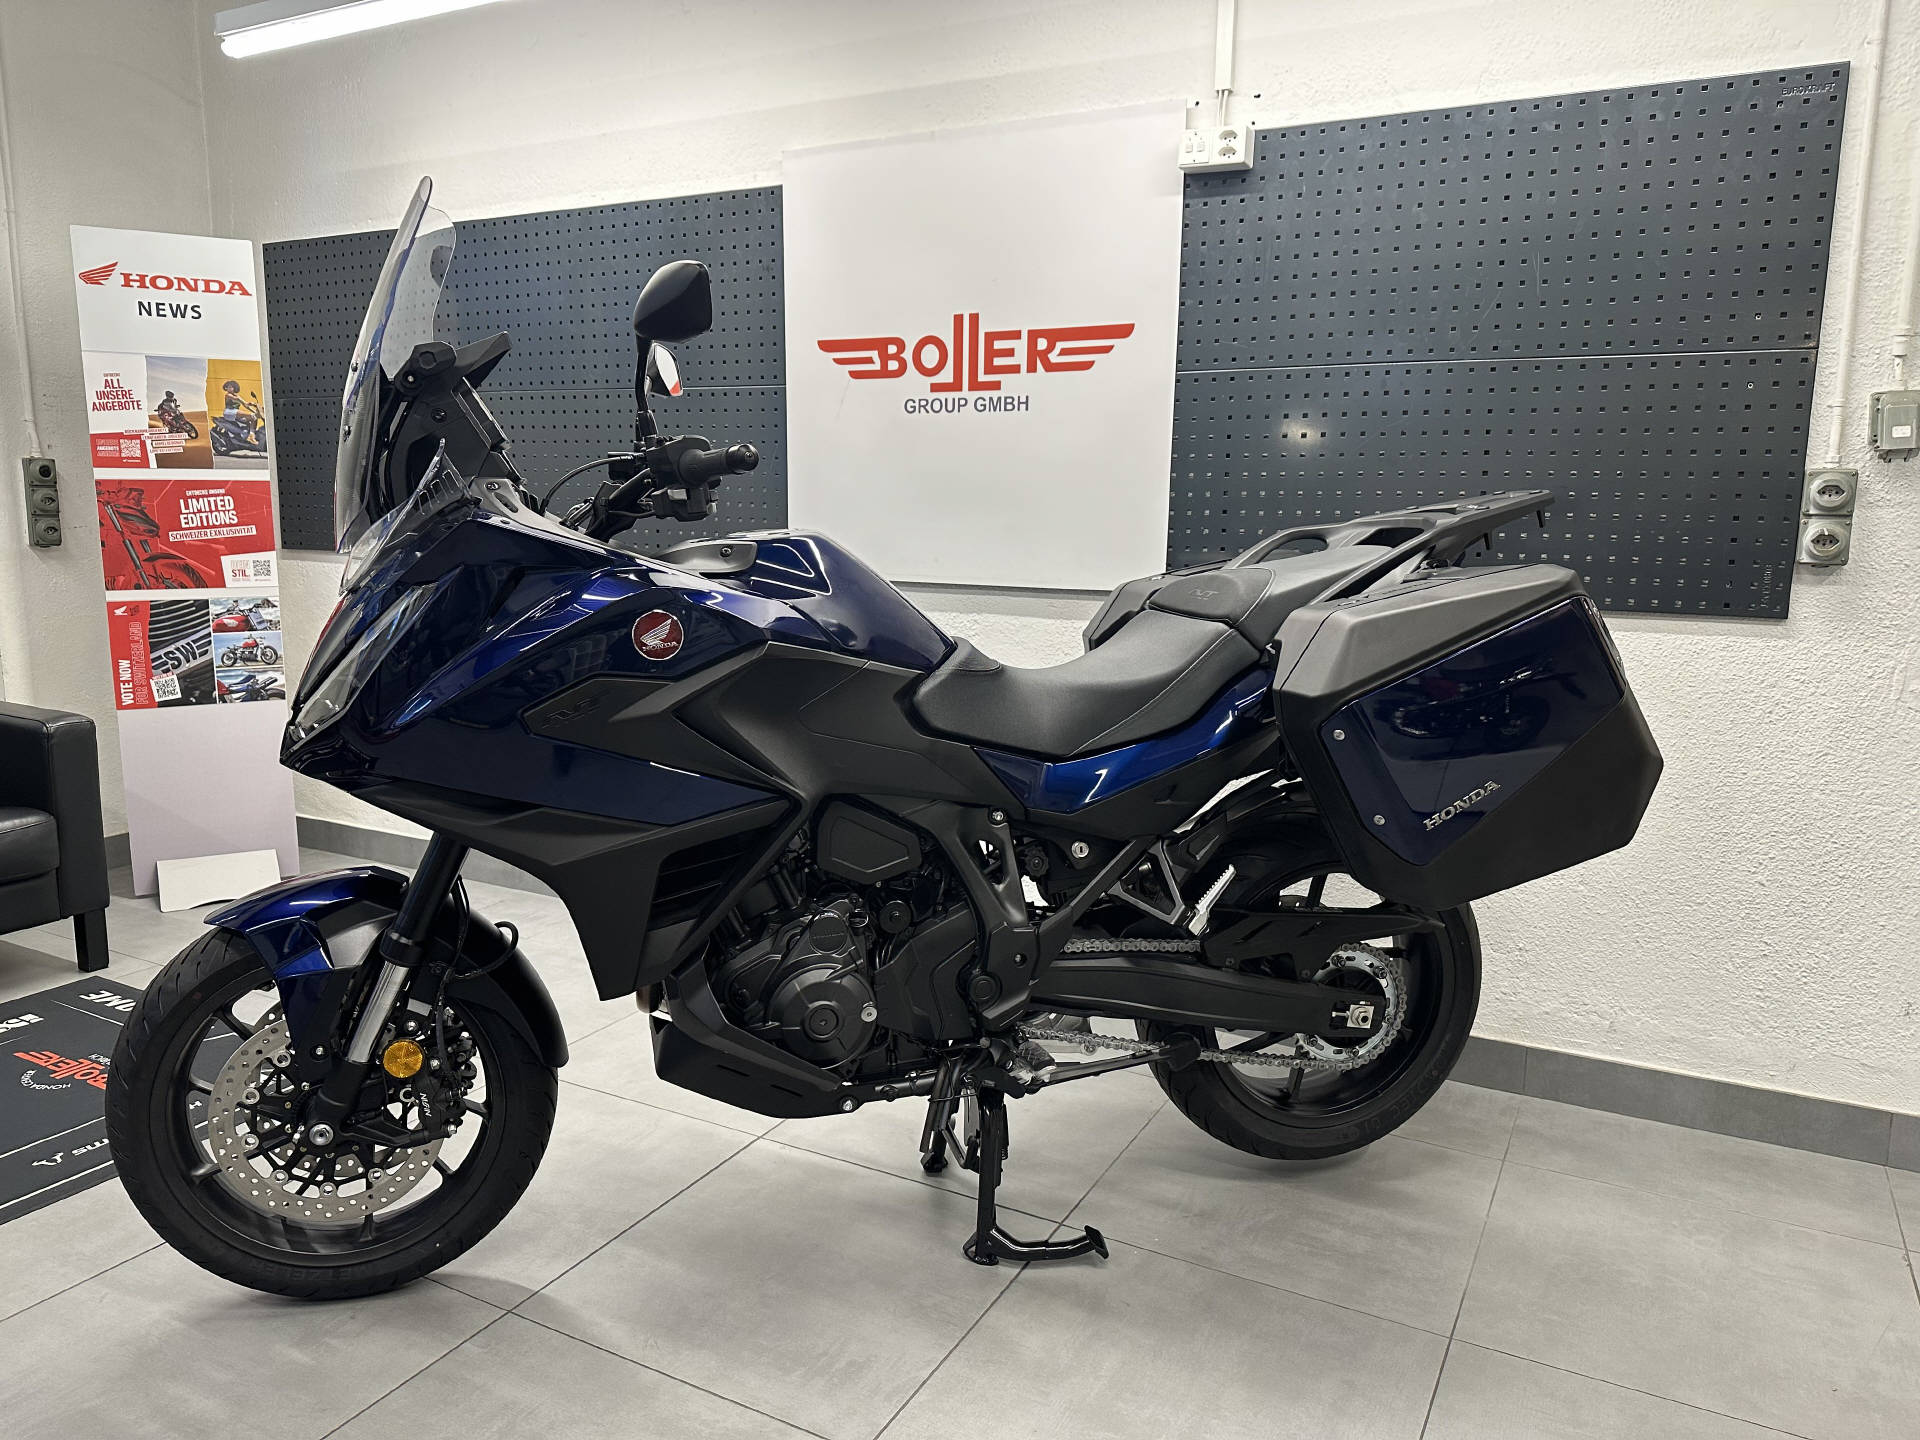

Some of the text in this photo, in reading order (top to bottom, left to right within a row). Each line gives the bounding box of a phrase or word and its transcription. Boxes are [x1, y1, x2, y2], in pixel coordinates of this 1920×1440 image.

[120, 272, 253, 297] HONDA
[137, 300, 202, 320] NEWS
[817, 312, 1136, 393] BOLLER
[103, 378, 124, 390] ALL
[95, 389, 134, 401] UNSERE
[92, 400, 143, 412] ANGEBOTE
[903, 395, 1030, 415] GROUP GMBH
[179, 495, 235, 514] LIMITED
[179, 510, 239, 529] EDITIONS
[170, 530, 209, 541] SCHWEIZER
[129, 621, 147, 685] SWITZERLAND
[642, 641, 680, 652] HONDA
[118, 659, 135, 706] VOTE NOW
[135, 686, 149, 705] FOR
[1422, 780, 1501, 831] HONDA
